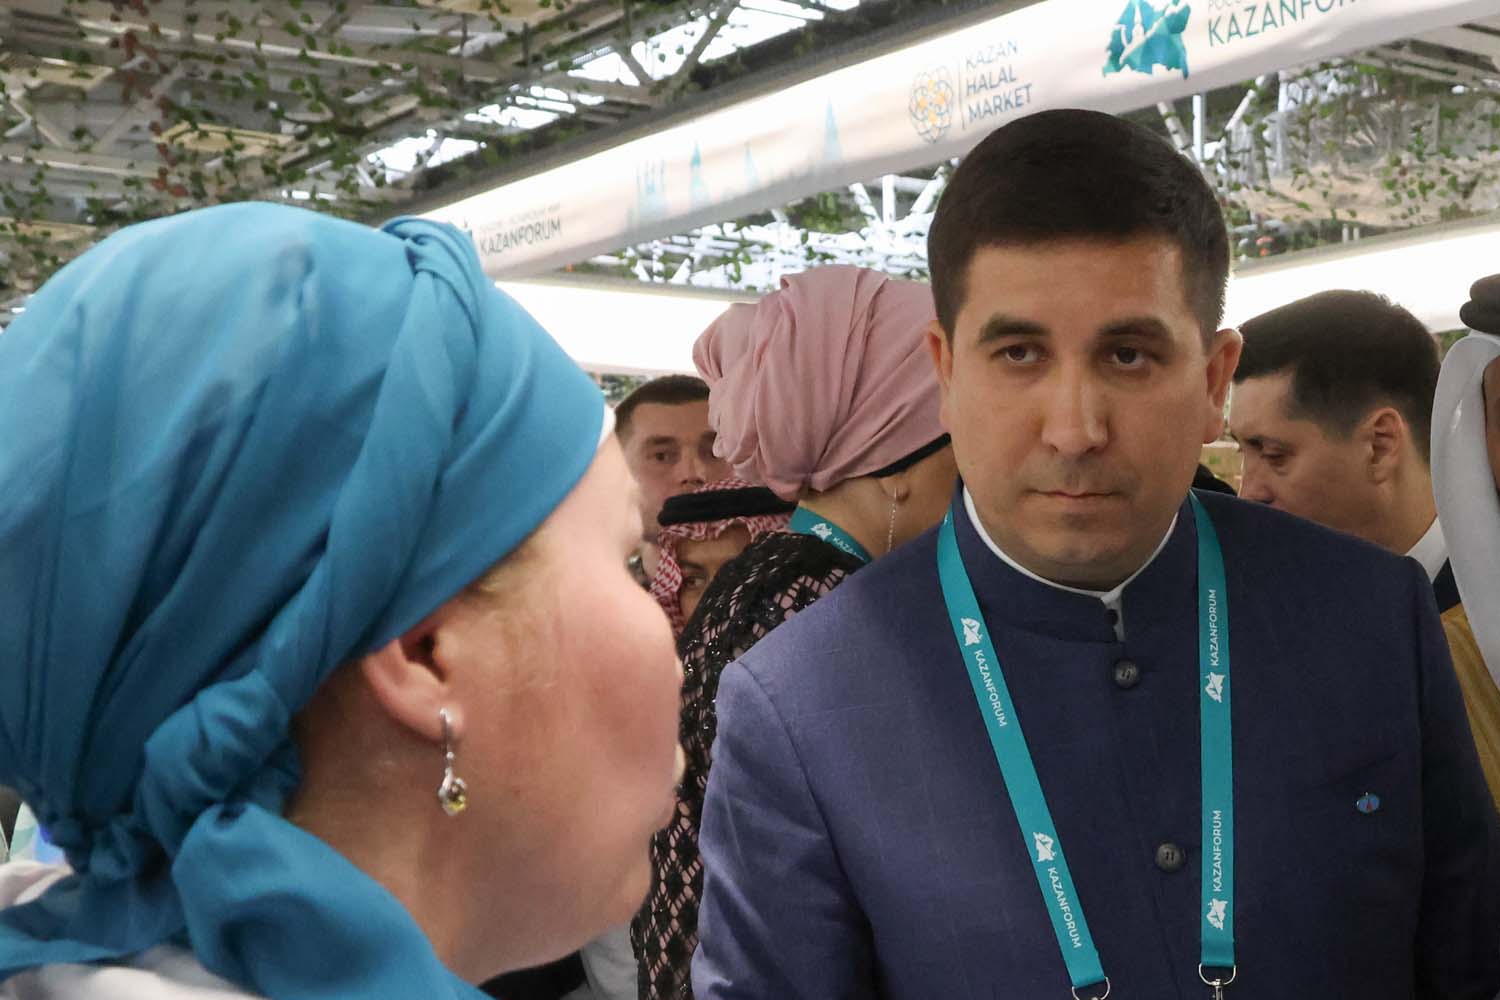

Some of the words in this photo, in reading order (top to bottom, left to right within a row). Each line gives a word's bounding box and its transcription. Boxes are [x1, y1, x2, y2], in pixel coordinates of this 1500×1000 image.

[966, 40, 1018, 72] KAZAN
[967, 64, 1016, 97] HALAL
[968, 83, 1032, 123] MARKET
[480, 216, 562, 256] KAZANFORUM
[1208, 589, 1219, 667] KAZANFORUM
[974, 649, 1007, 727] KAZANFORUM
[1212, 810, 1222, 892] KAZANFORUM
[1047, 867, 1082, 949] KAZANFORUM
